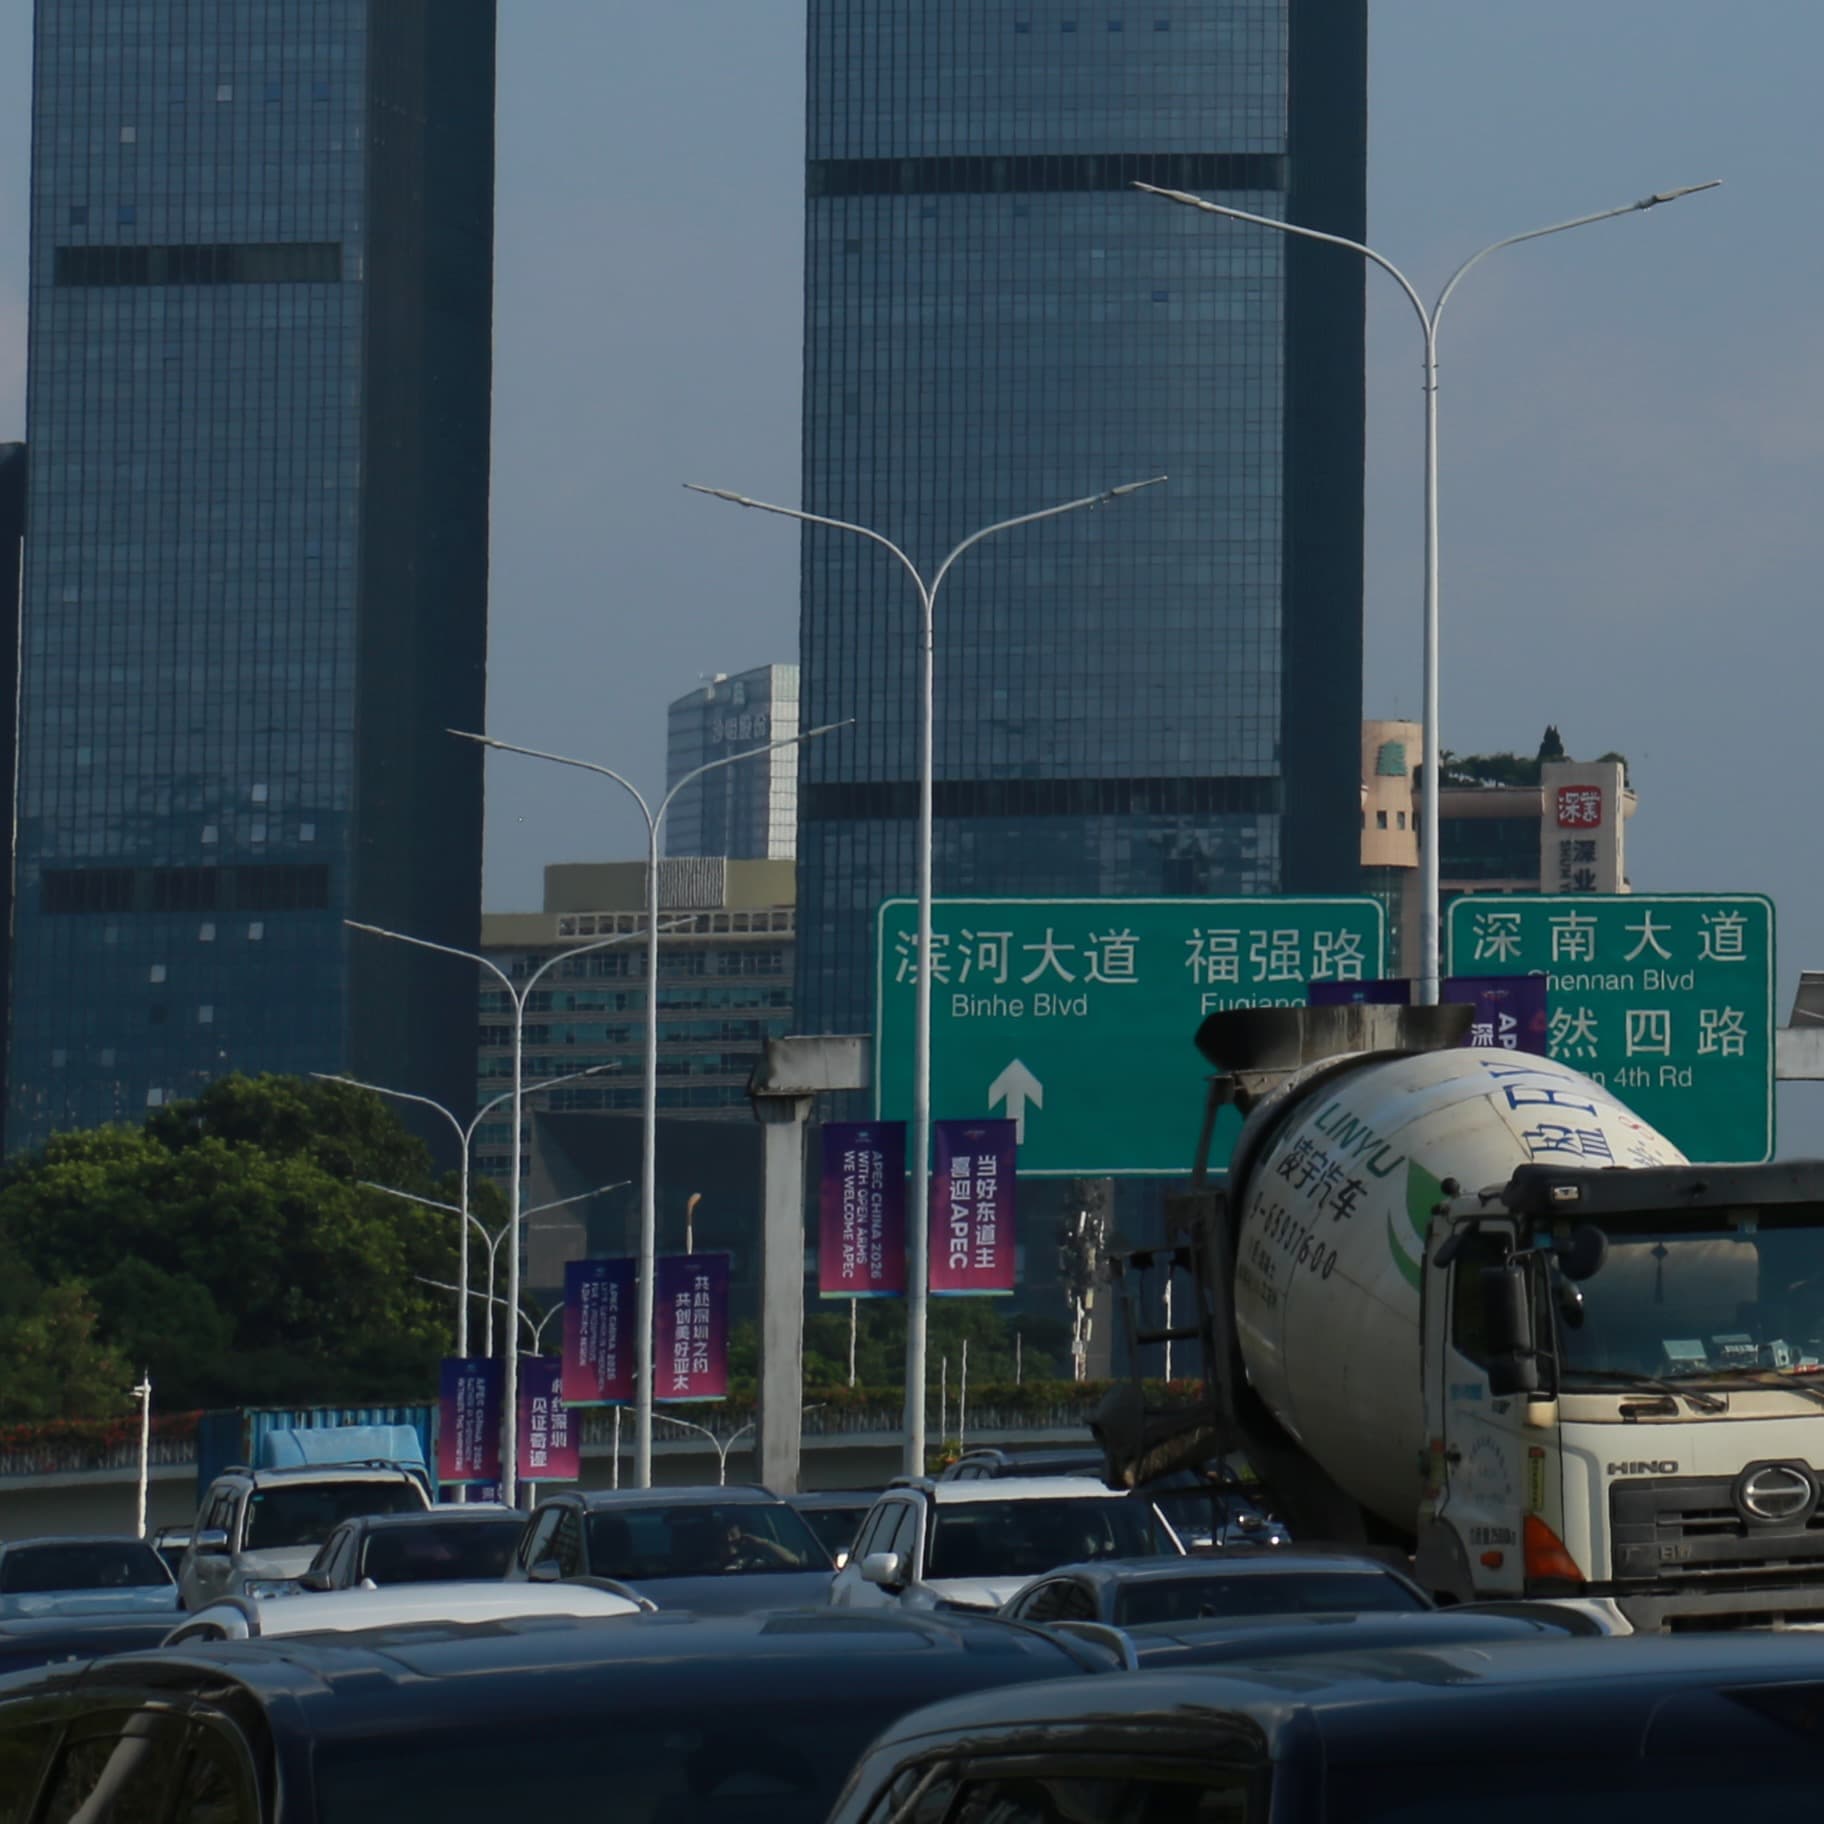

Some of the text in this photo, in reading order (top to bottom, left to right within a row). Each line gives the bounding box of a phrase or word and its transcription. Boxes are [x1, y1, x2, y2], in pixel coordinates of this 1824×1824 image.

[895, 927, 1141, 985] 滨河大道
[1184, 927, 1367, 984] 福强路
[1472, 909, 1748, 963] 深南大道
[951, 992, 1088, 1018] Binhe Blvd
[1527, 968, 1695, 992] hennan Blvd
[1547, 1005, 1748, 1058] 然四路
[1613, 1066, 1651, 1088] 4th
[1659, 1065, 1693, 1087] Rd
[1315, 1101, 1405, 1179] LINYU
[857, 1150, 870, 1186] WITH
[842, 1150, 856, 1279] WE WELCOME APEC
[856, 1188, 869, 1222] OPEN
[870, 1150, 884, 1280] APEC CHINA 2026
[974, 1154, 998, 1269] 当好东道主
[673, 1292, 691, 1391] 共创美好亚太
[1608, 1460, 1679, 1474] HINO
